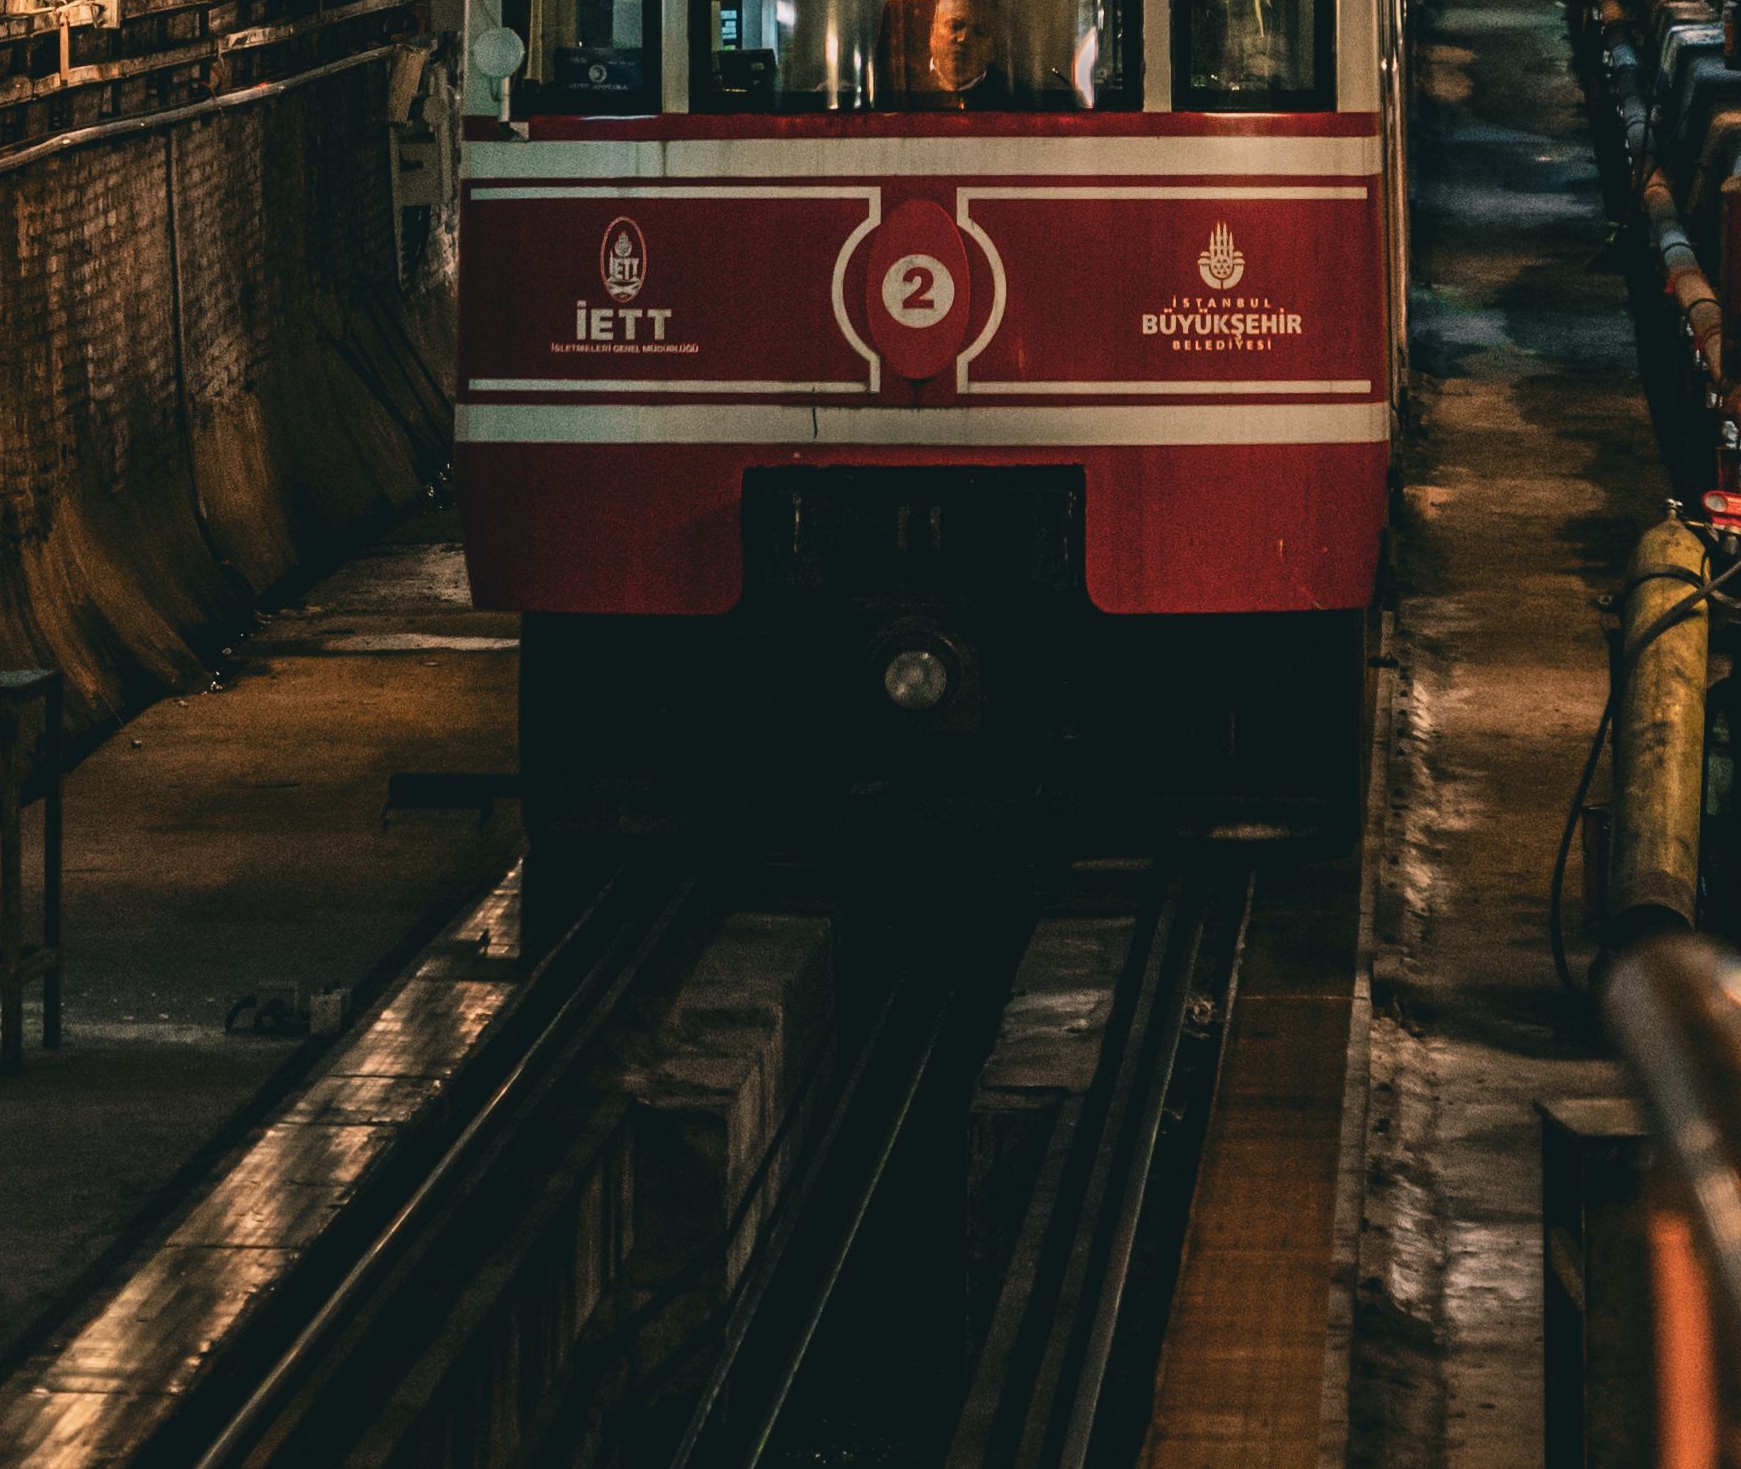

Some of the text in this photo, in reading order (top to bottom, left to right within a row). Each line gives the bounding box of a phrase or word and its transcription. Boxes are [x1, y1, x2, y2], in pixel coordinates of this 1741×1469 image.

[902, 267, 934, 309] 2
[1172, 294, 1272, 308] İSTANBUL
[576, 300, 672, 340] İETT
[1142, 308, 1302, 341] BÜYÜKŞEHİR
[1172, 338, 1272, 350] BELEDİYESİ
